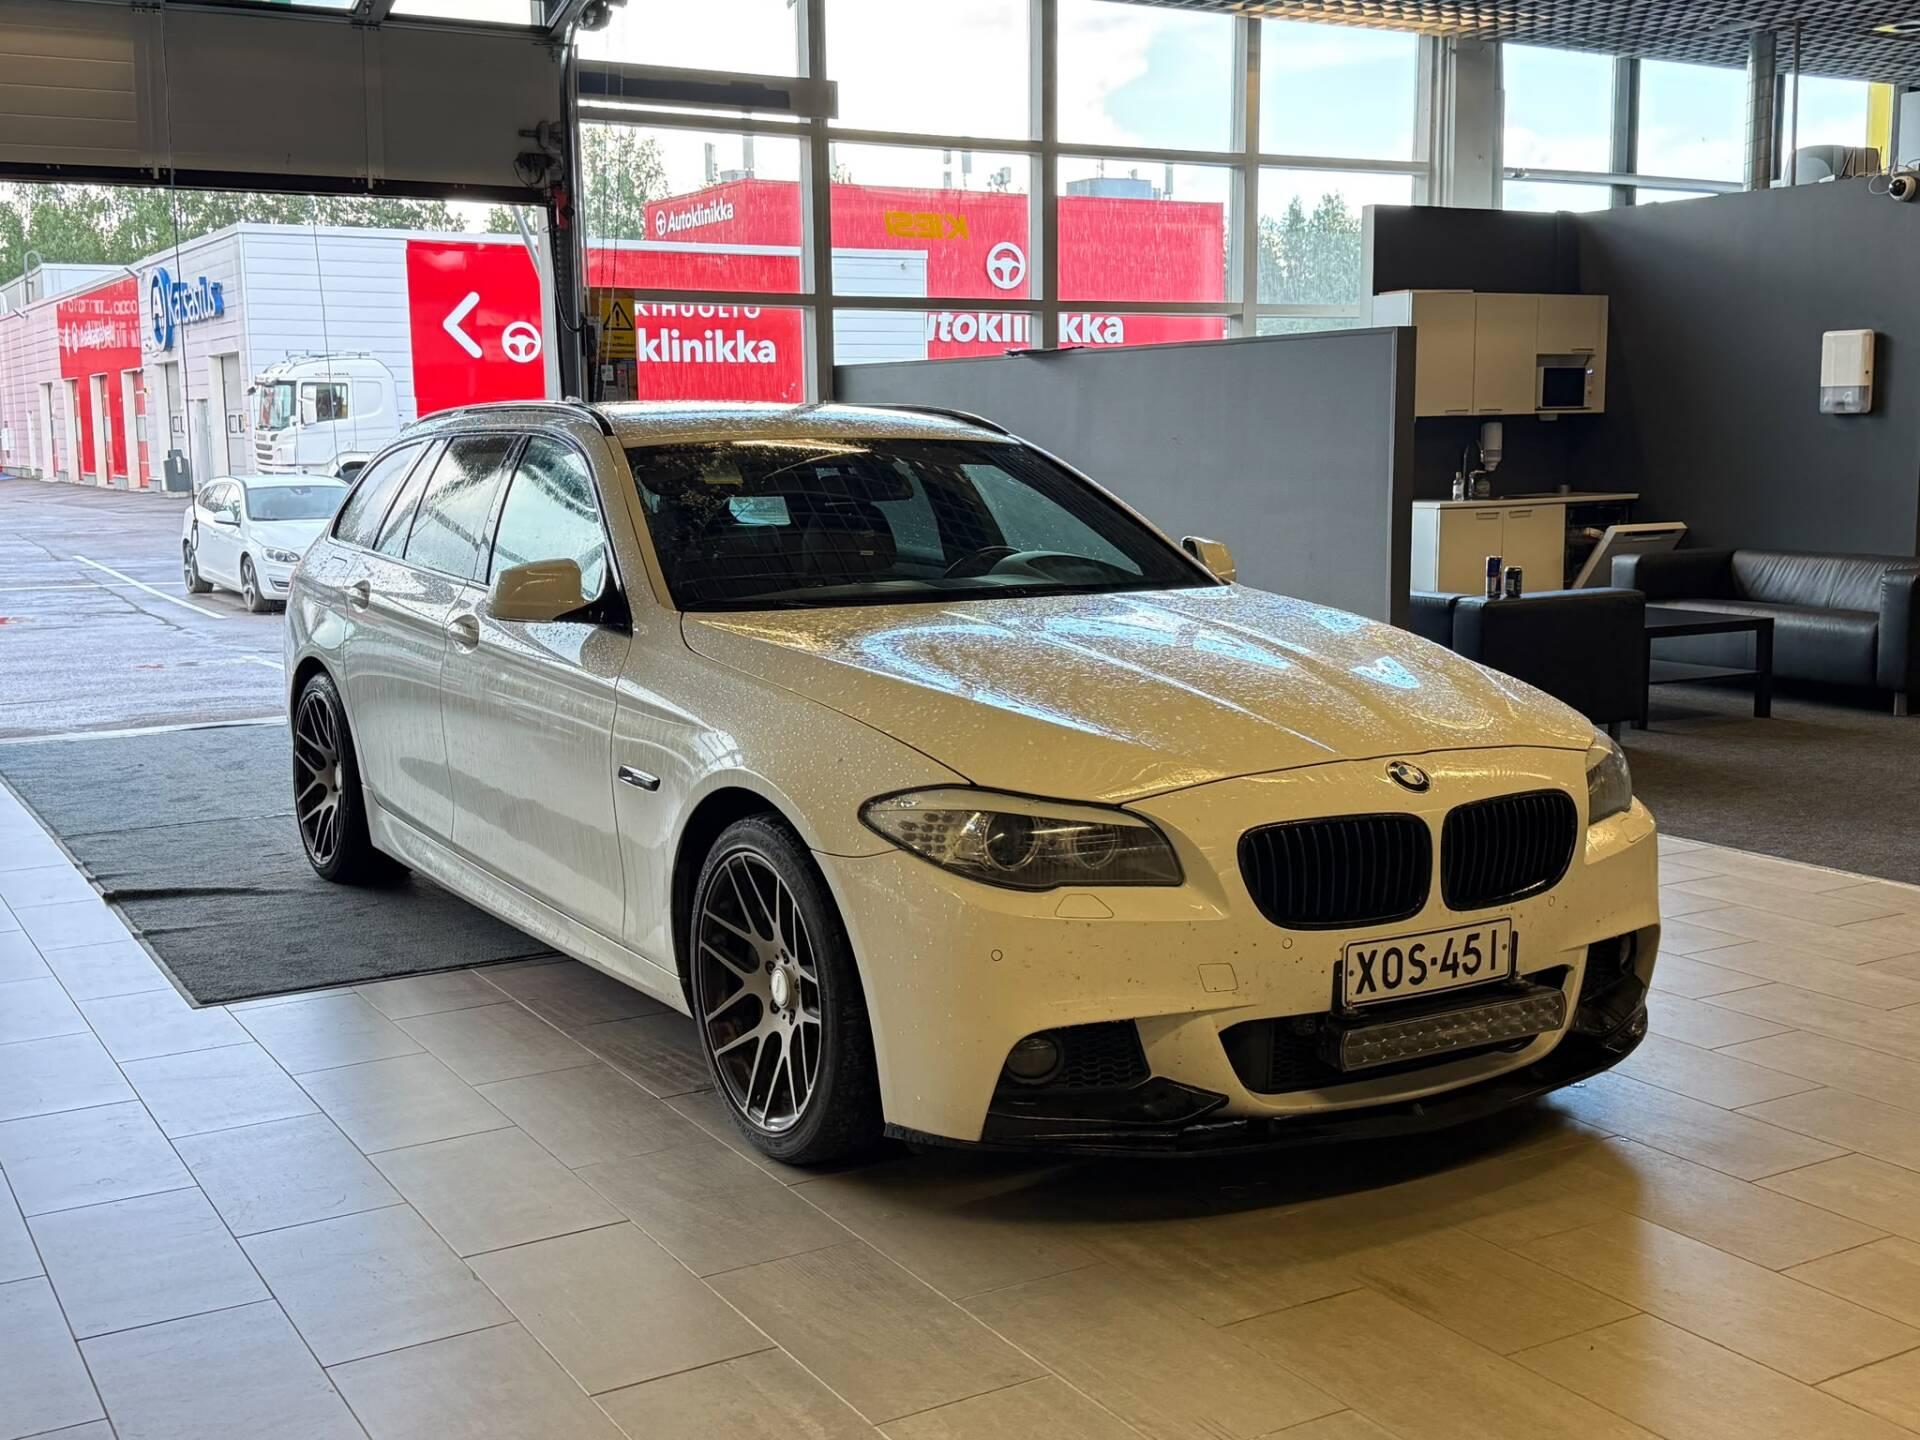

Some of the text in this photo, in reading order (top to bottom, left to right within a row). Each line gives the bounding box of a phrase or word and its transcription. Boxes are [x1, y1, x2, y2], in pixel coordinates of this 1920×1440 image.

[667, 198, 735, 232] Autoklinikka
[639, 327, 777, 364] klinikka
[1356, 930, 1497, 995] XOS-451
